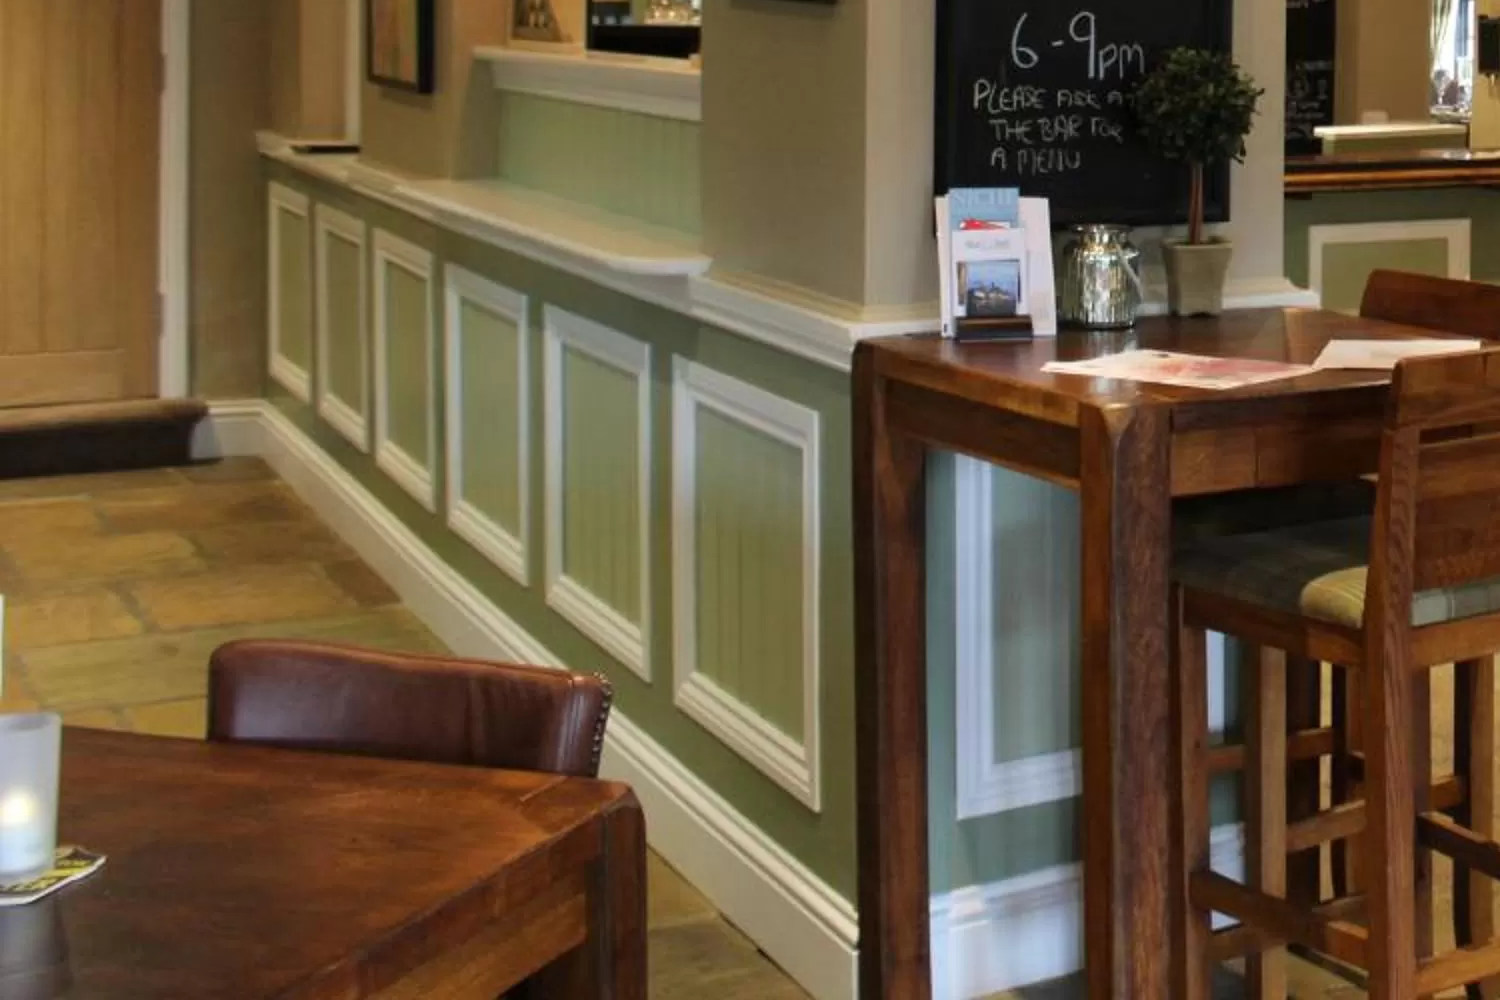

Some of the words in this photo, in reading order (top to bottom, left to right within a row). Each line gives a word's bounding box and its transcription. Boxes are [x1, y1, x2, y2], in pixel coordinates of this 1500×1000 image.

[973, 79, 1047, 114] PLEASE
[1056, 89, 1101, 110] ASK
[988, 119, 1034, 145] THE
[1037, 115, 1083, 142] BAR
[990, 147, 1008, 170] A
[1017, 148, 1081, 176] MENU
